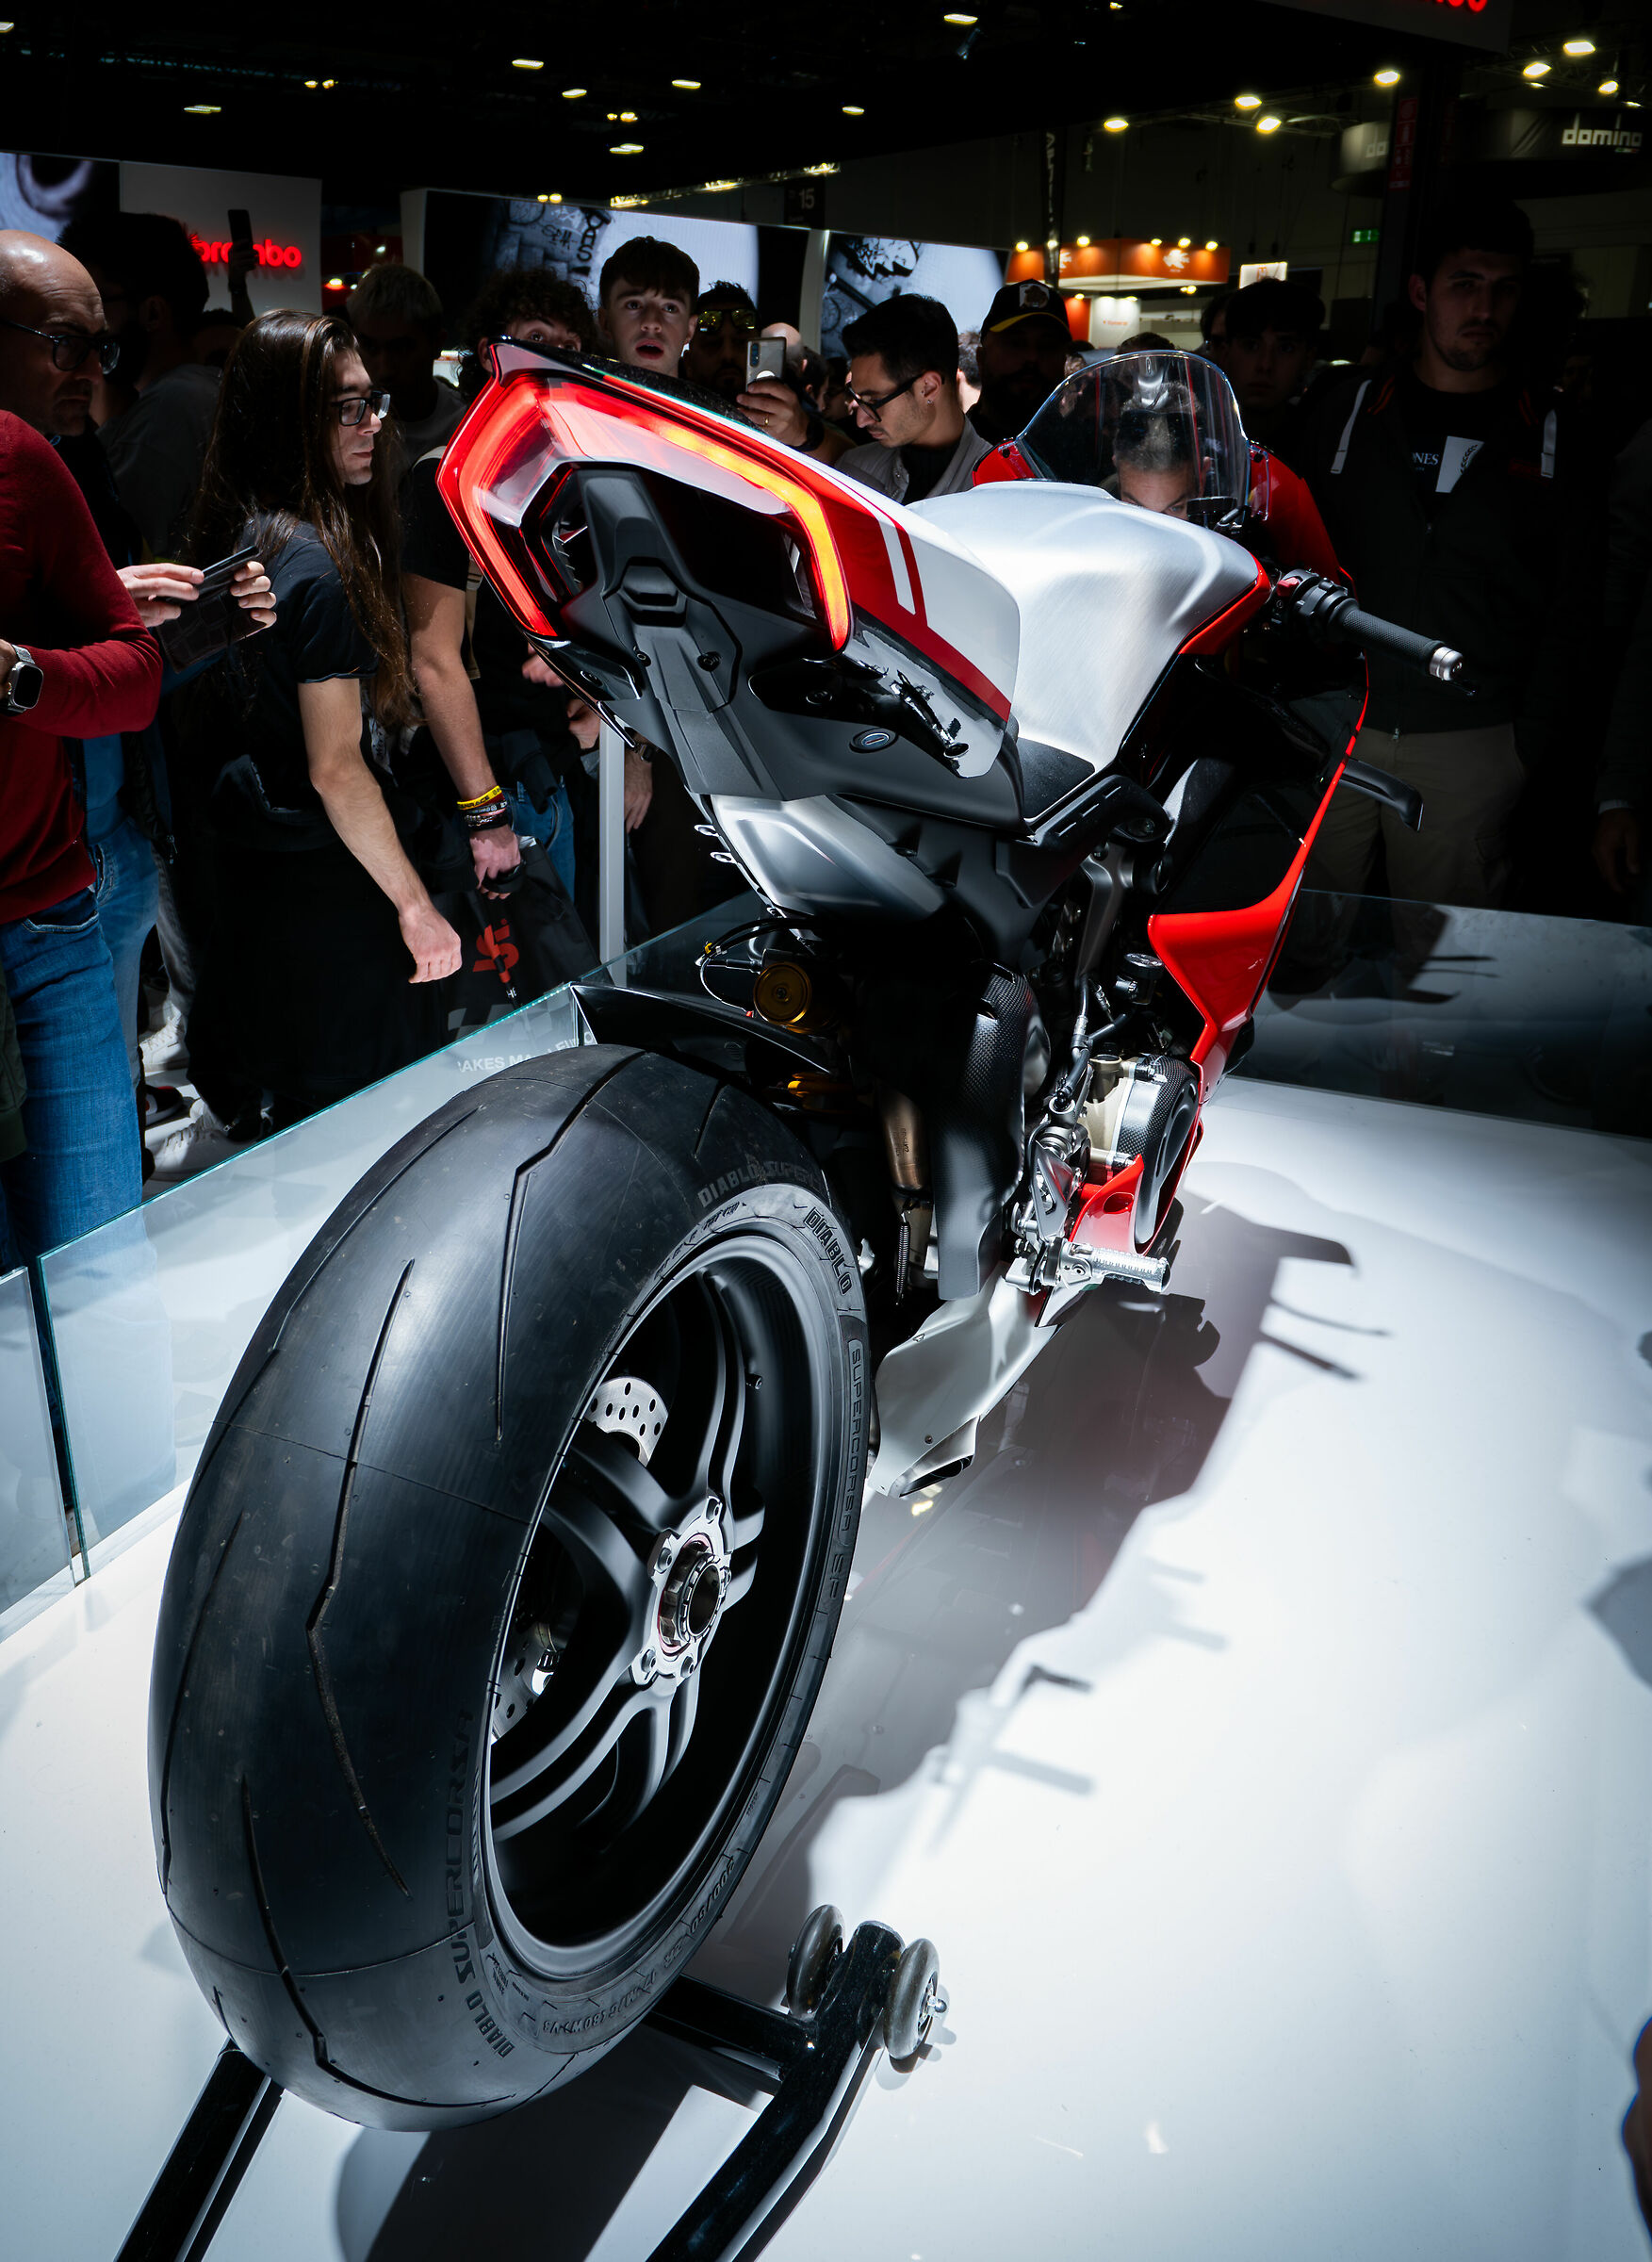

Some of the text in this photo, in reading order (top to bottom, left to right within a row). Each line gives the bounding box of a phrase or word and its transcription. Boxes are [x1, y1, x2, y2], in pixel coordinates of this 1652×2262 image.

[1562, 112, 1644, 147] domino
[457, 1056, 506, 1073] AKES
[697, 1165, 758, 1208] DIABLO
[803, 1206, 853, 1296] DIABLO
[829, 1348, 861, 1599] SUPERCORSA SP
[446, 1709, 476, 1984] SUPERCORSA
[466, 1989, 515, 2058] DIABLO
